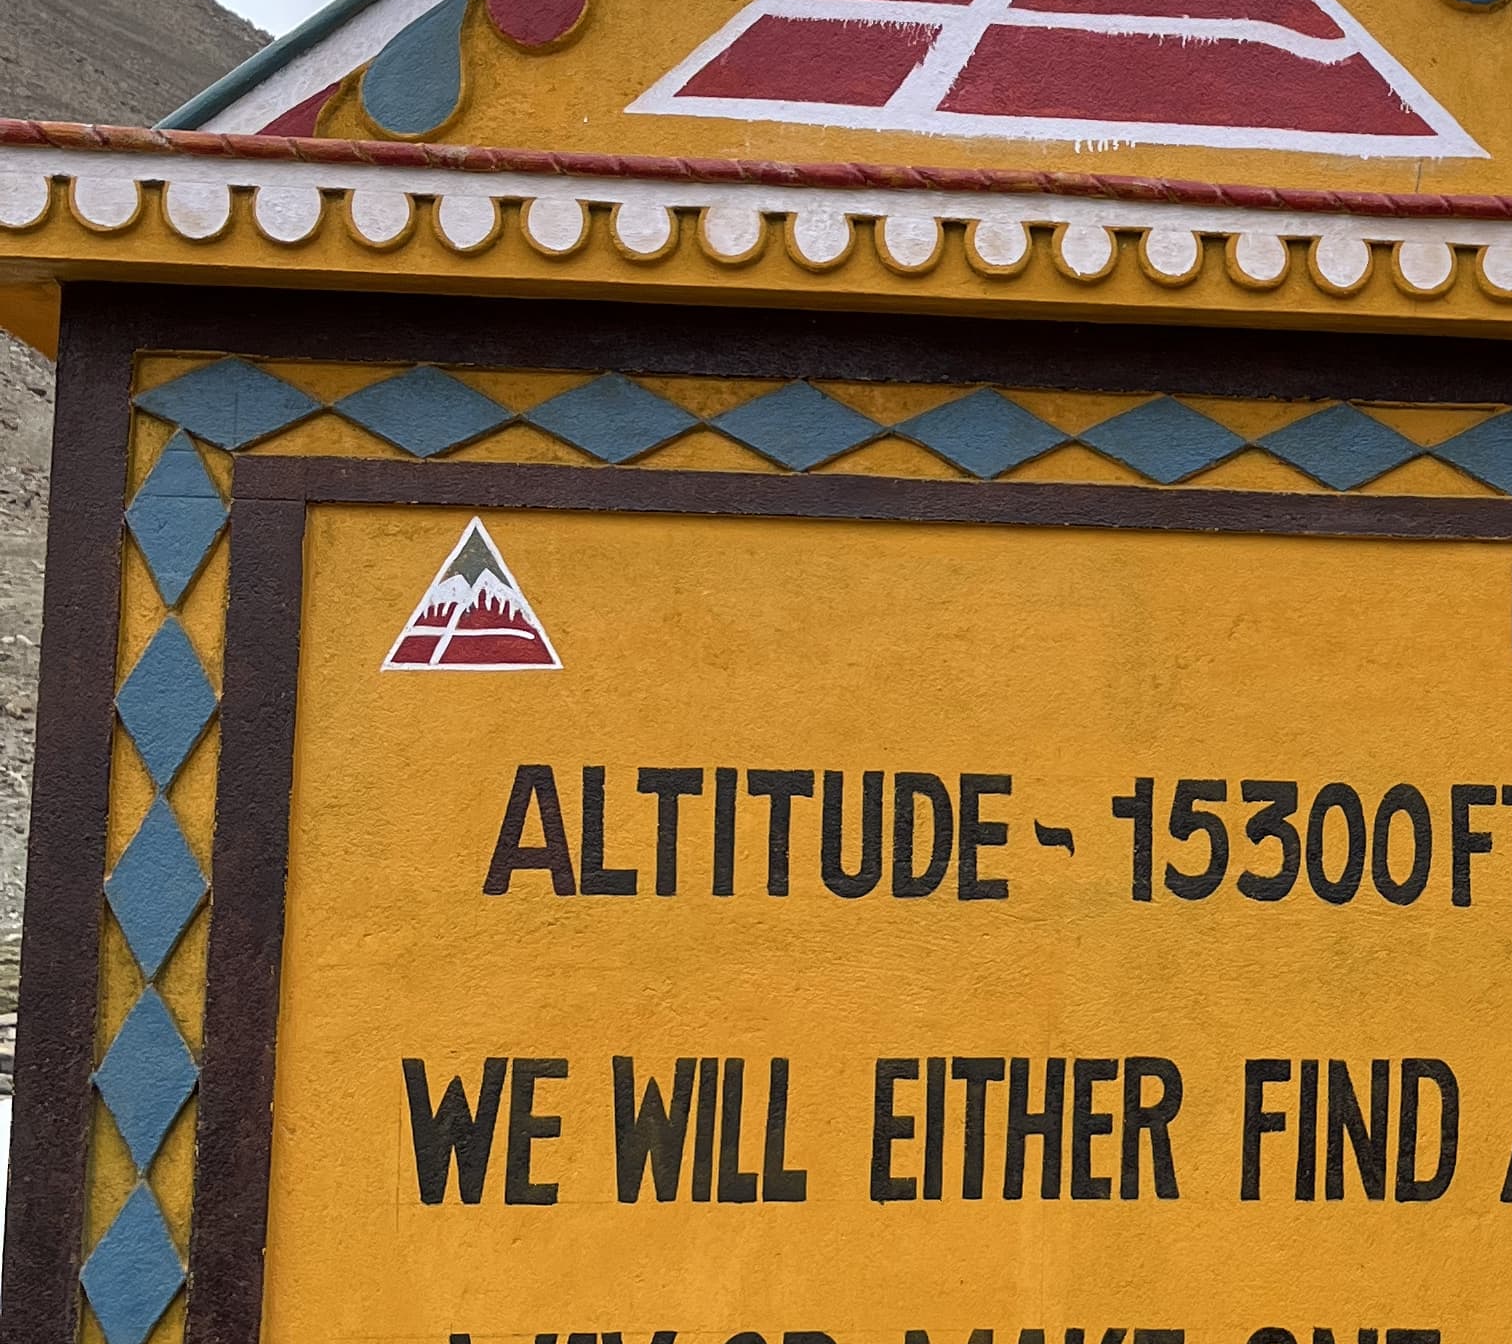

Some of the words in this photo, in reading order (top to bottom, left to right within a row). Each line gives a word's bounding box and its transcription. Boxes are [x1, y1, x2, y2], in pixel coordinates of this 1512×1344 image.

[401, 1056, 569, 1206] WE
[612, 1055, 807, 1204] WILL
[869, 1056, 1184, 1206] EITHER
[1240, 1057, 1460, 1204] FIND
